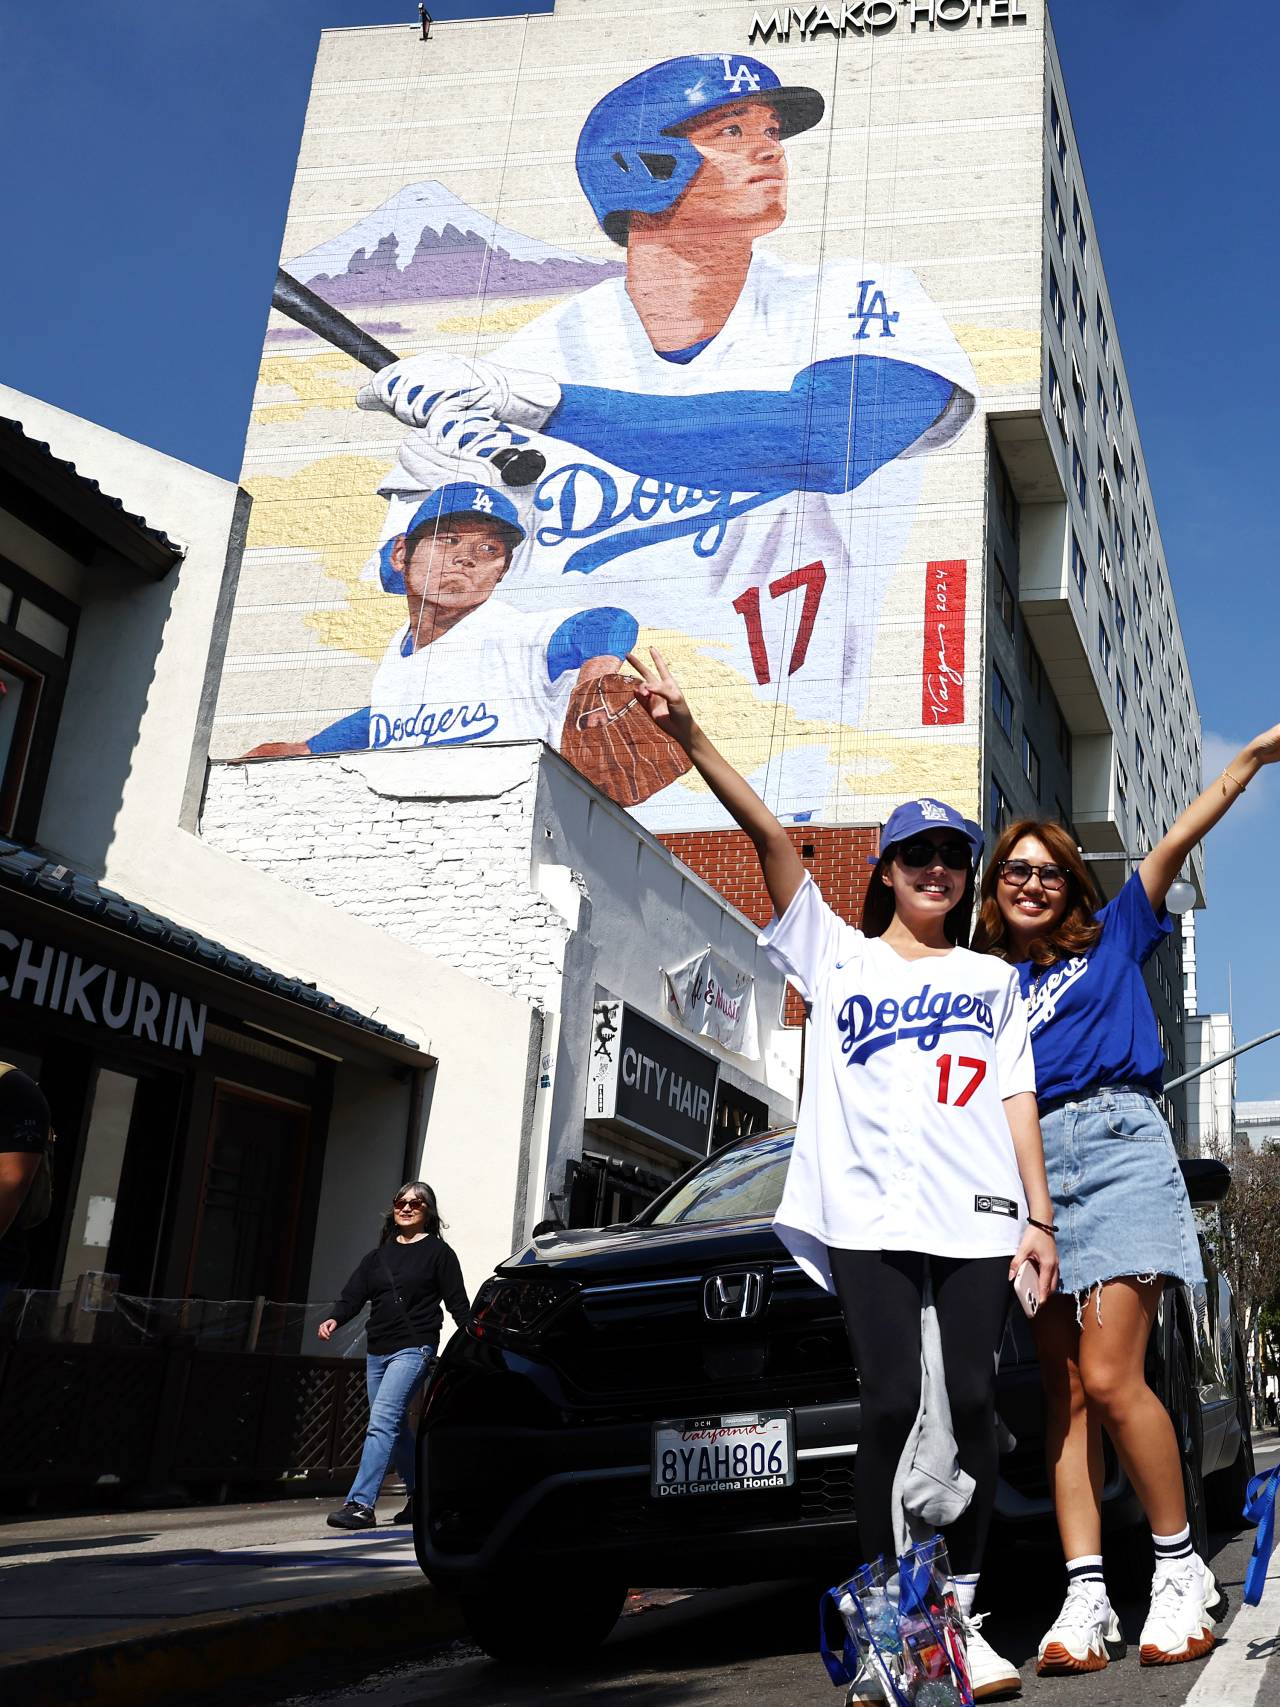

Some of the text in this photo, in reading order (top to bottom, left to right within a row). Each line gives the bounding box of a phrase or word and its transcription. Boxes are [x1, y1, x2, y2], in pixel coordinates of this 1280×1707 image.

[749, 0, 1027, 36] MIYAKO HOTEL
[719, 55, 761, 93] LA
[848, 280, 900, 340] LA
[472, 488, 494, 513] LA
[936, 569, 948, 612] 2024
[732, 560, 827, 685] 17
[369, 703, 498, 749] Dodgers
[917, 800, 949, 821] LA
[838, 984, 994, 1053] Dodgers
[622, 1046, 668, 1101] CITY
[668, 1071, 710, 1125] HAIR
[936, 1053, 987, 1108] 17
[694, 1420, 711, 1428] DCH
[662, 1439, 783, 1483] 8YAH806
[660, 1475, 784, 1496] DCH Gardena Honda
